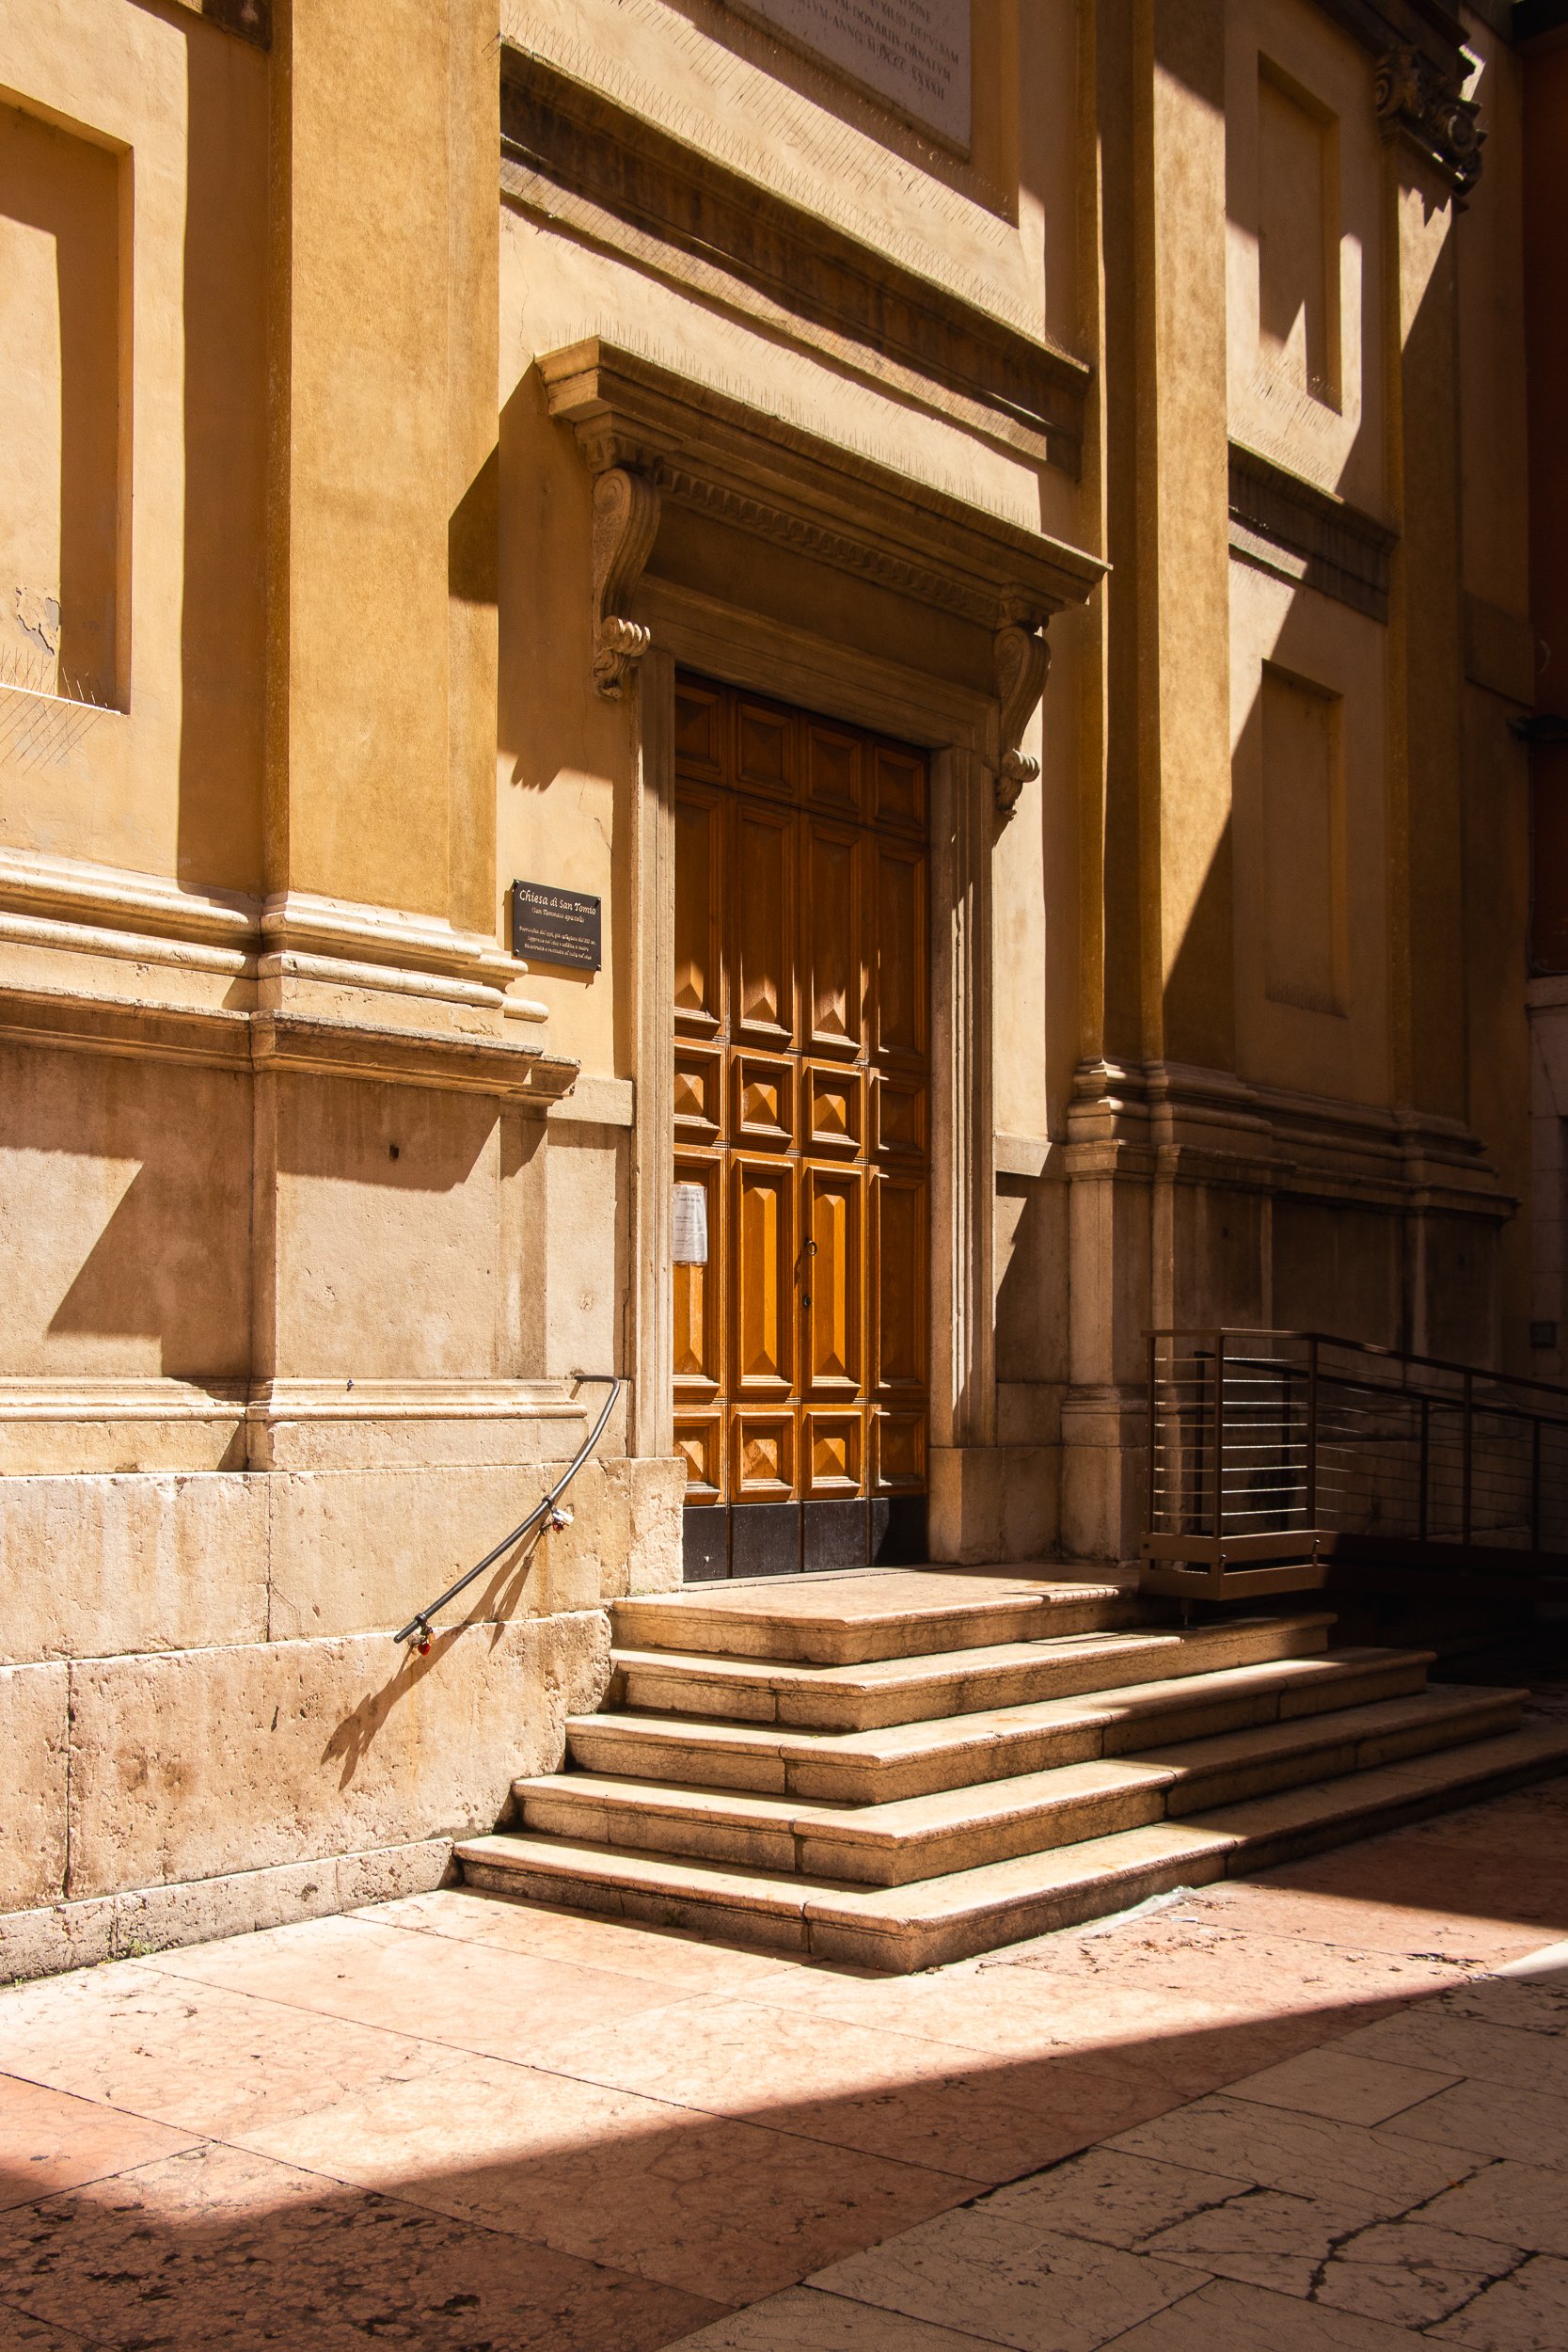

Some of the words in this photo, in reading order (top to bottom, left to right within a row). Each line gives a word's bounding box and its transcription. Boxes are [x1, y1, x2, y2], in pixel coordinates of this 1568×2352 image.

[520, 890, 548, 905] Chiesa
[550, 898, 558, 908] di
[560, 899, 573, 911] San
[574, 902, 596, 914] Tomio
